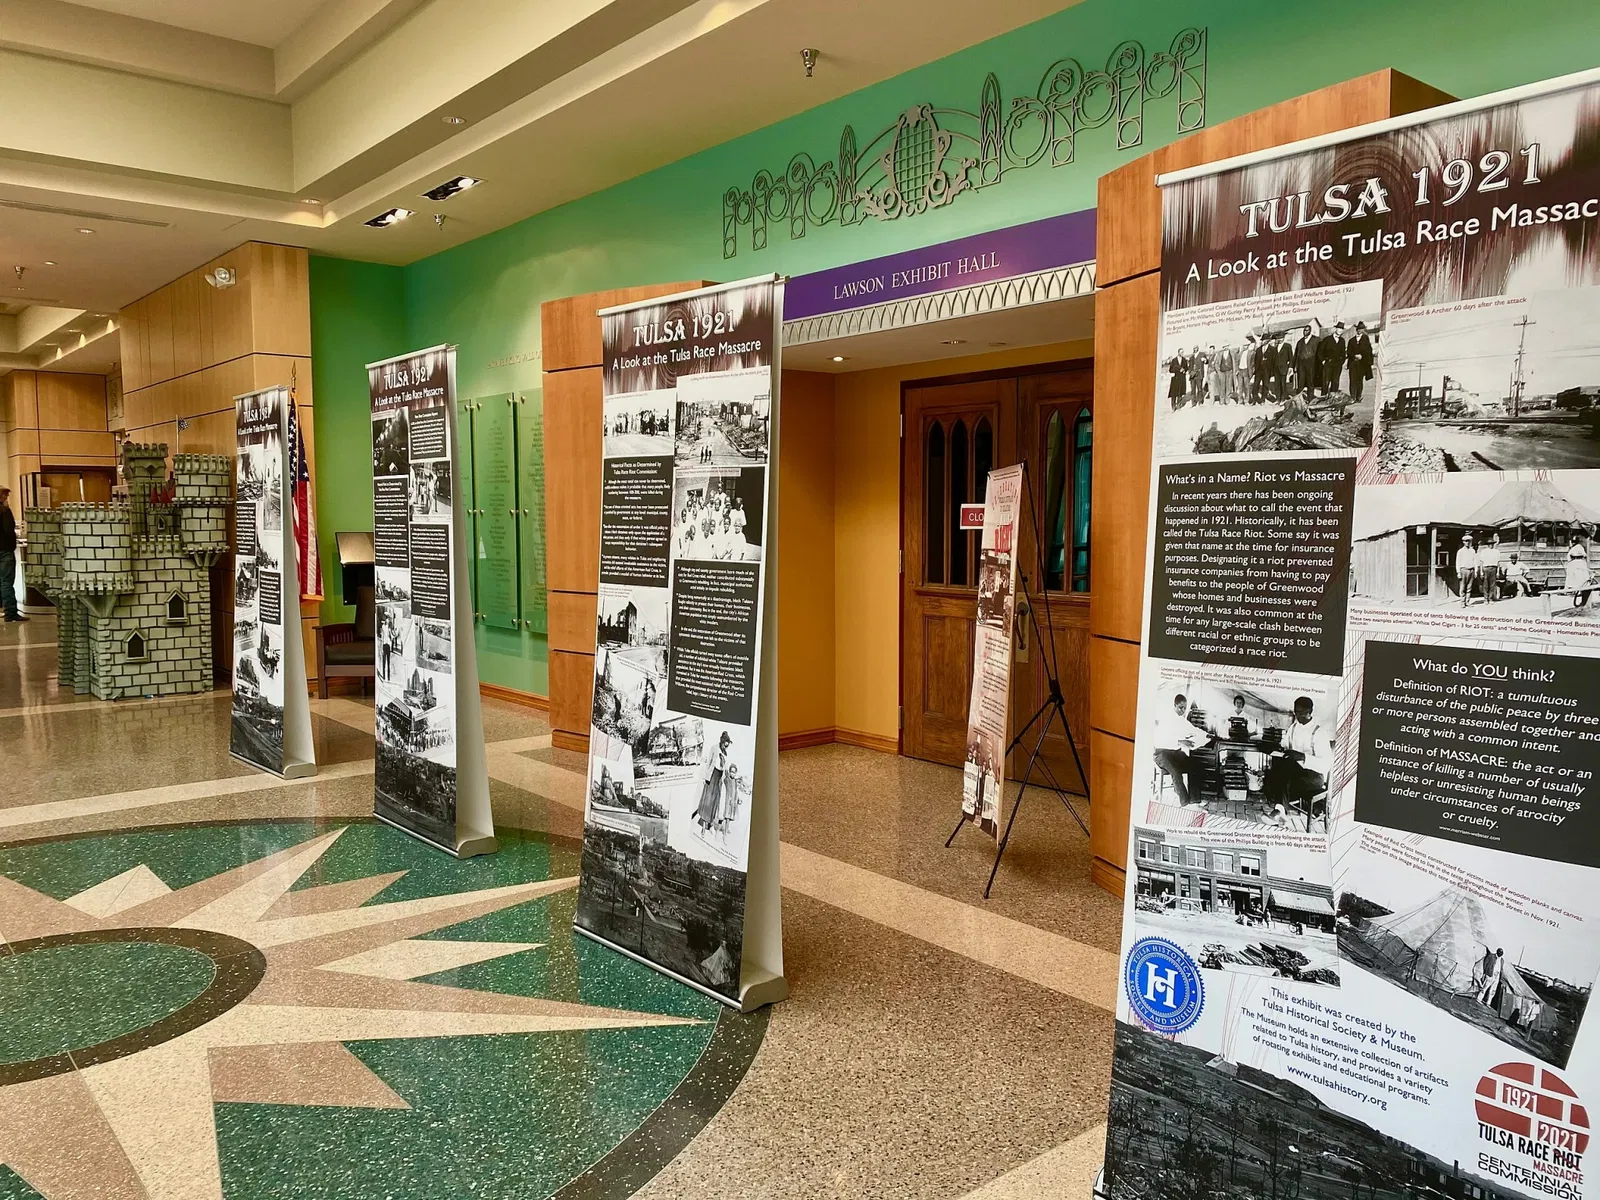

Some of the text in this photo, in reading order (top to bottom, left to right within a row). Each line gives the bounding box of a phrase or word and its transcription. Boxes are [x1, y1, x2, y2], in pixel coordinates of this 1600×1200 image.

[1240, 143, 1541, 238] TULSA 1921
[1185, 198, 1598, 284] A Look at the Tulsa Race Massac
[834, 252, 1001, 300] LAWSON EXHIBIT HALL
[632, 310, 734, 347] TULSA 1921
[1390, 312, 1424, 320] Greenwood
[1431, 306, 1452, 315] Archer
[612, 340, 761, 370] A Look at the Tulsa Race Massacre
[384, 366, 430, 390] TULSA 1921
[375, 398, 378, 406] A
[412, 389, 422, 400] Race
[1165, 473, 1195, 484] What's
[1197, 474, 1205, 482] in
[1217, 472, 1250, 482] Name?
[1254, 472, 1276, 481] Riot
[1294, 471, 1344, 481] Massacre
[1163, 504, 1199, 512] discussion
[1200, 503, 1223, 511] about
[1225, 503, 1246, 511] what
[1260, 502, 1275, 511] call
[1278, 502, 1293, 511] the
[1324, 502, 1342, 511] that
[1171, 491, 1178, 499] In
[1206, 492, 1227, 501] years
[1229, 490, 1252, 498] there
[1254, 489, 1269, 498] has
[1272, 489, 1294, 498] been
[1296, 489, 1333, 501] ongoing
[968, 513, 984, 521] CLO
[1349, 608, 1362, 617] Many
[1534, 617, 1572, 626] Greenwood
[1413, 658, 1554, 682] What do YOU think?
[1376, 691, 1599, 724] disturbance of the public peace by three
[1393, 678, 1442, 692] Definition
[1445, 684, 1457, 693] of
[1460, 685, 1493, 697] RIOT:
[1508, 692, 1577, 706] tumultuous
[1386, 708, 1413, 718] more
[1415, 712, 1456, 723] persons
[1459, 718, 1518, 731] assembled
[1521, 724, 1575, 737] together
[1458, 814, 1498, 829] cruelty.
[1133, 945, 1194, 982] TULSA HISTORICAL
[1130, 980, 1196, 1025] SOCIETY AND MUSEUM
[1270, 986, 1415, 1043] This exhibit was created by the
[1261, 997, 1424, 1061] Tulsa Historical Society & Museum.
[1241, 1006, 1254, 1018] The
[1256, 1012, 1286, 1029] Museum
[1288, 1023, 1307, 1037] holds
[1321, 1037, 1358, 1054] extensive
[1360, 1050, 1400, 1069] collection
[1403, 1065, 1412, 1073] of
[1414, 1069, 1448, 1086] artifacts
[1252, 1024, 1276, 1037] related
[1289, 1034, 1308, 1049] Tulsa
[1310, 1043, 1339, 1061] history,
[1342, 1056, 1356, 1066] and
[1358, 1062, 1394, 1079] provides
[1403, 1078, 1432, 1094] variety
[1261, 1038, 1290, 1056] rotating
[1291, 1050, 1320, 1065] exhibits
[1323, 1061, 1337, 1071] and
[1339, 1067, 1385, 1088] educational
[1387, 1084, 1430, 1105] programs.
[1287, 1065, 1388, 1111] www.tulsahistory.org
[1505, 1086, 1538, 1112] 1921
[1478, 1122, 1582, 1172] TULSA RACE RIOT
[1540, 1124, 1578, 1153] 2021
[1478, 1152, 1582, 1195] CENTENNIAL
[1478, 1160, 1582, 1200] COMMISSION
[1533, 1160, 1584, 1184] MASSACRE
